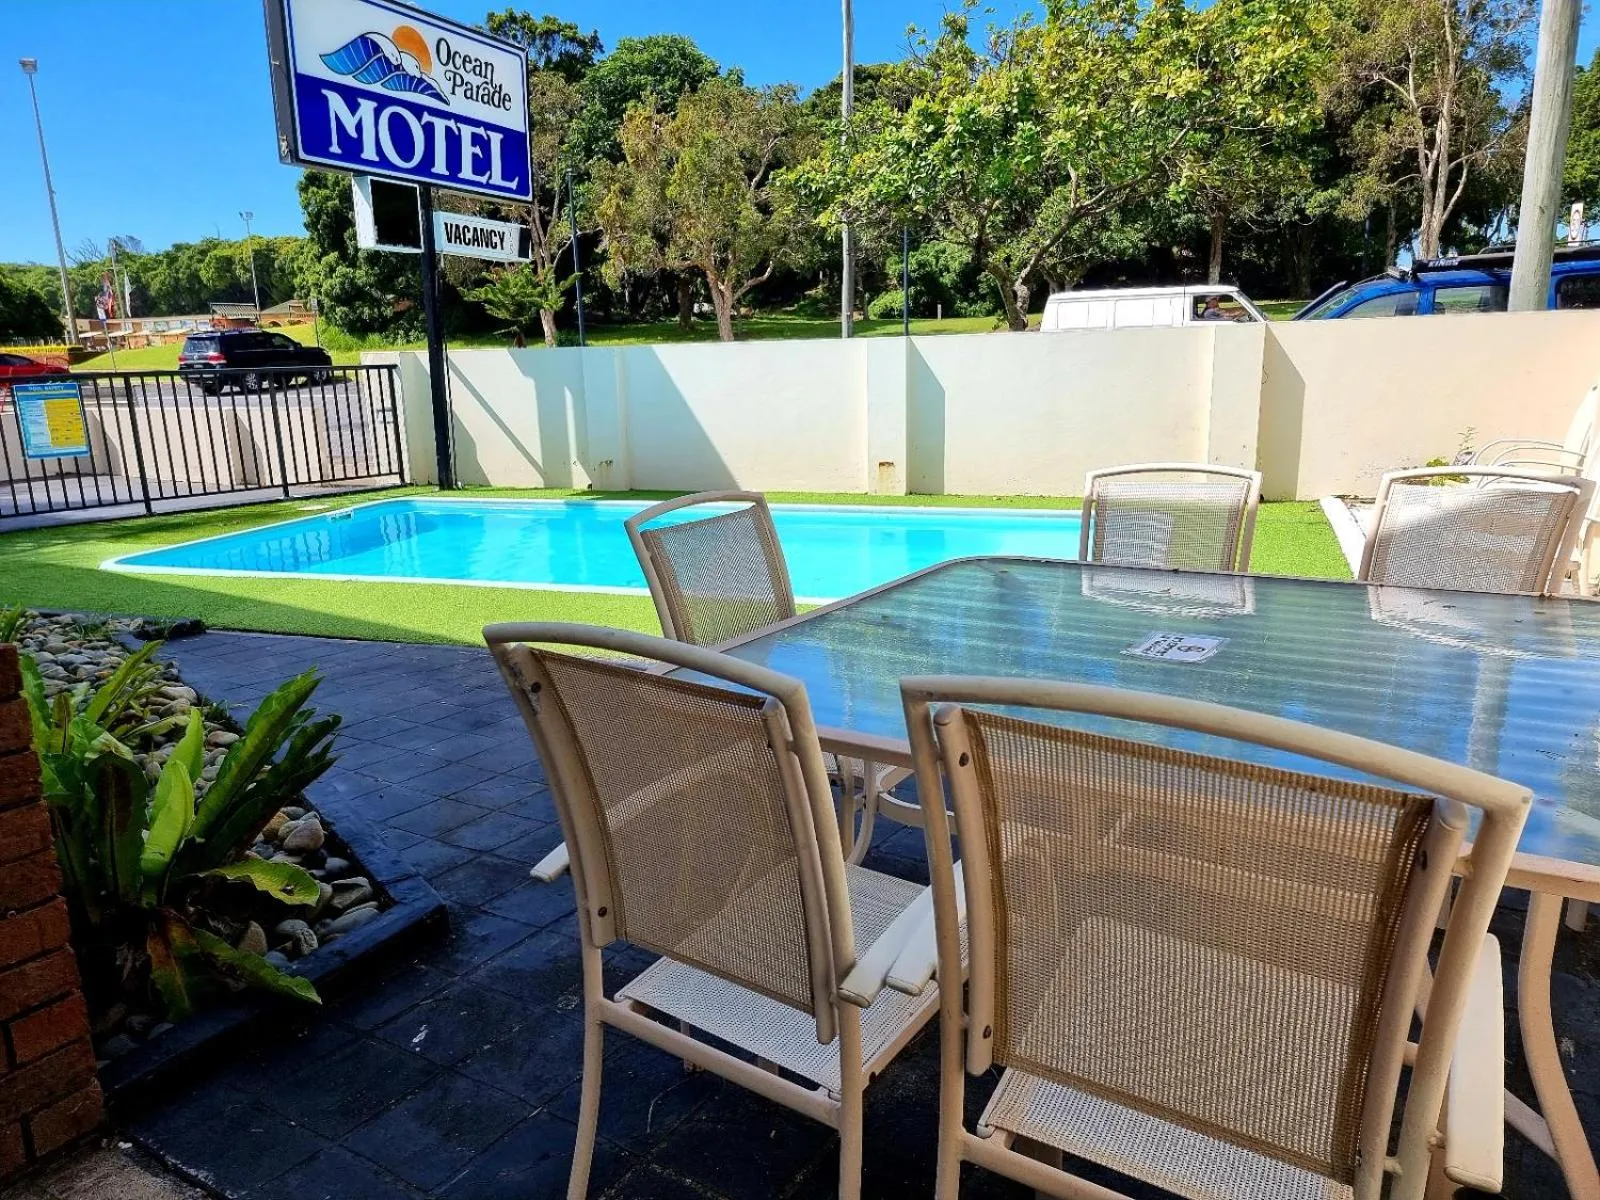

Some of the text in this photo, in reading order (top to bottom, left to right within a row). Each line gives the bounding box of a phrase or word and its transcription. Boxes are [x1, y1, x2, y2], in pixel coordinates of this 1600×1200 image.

[436, 38, 496, 87] Ocean
[445, 71, 512, 111] Parade
[321, 89, 519, 190] MOTEL
[444, 222, 506, 250] VACANCY
